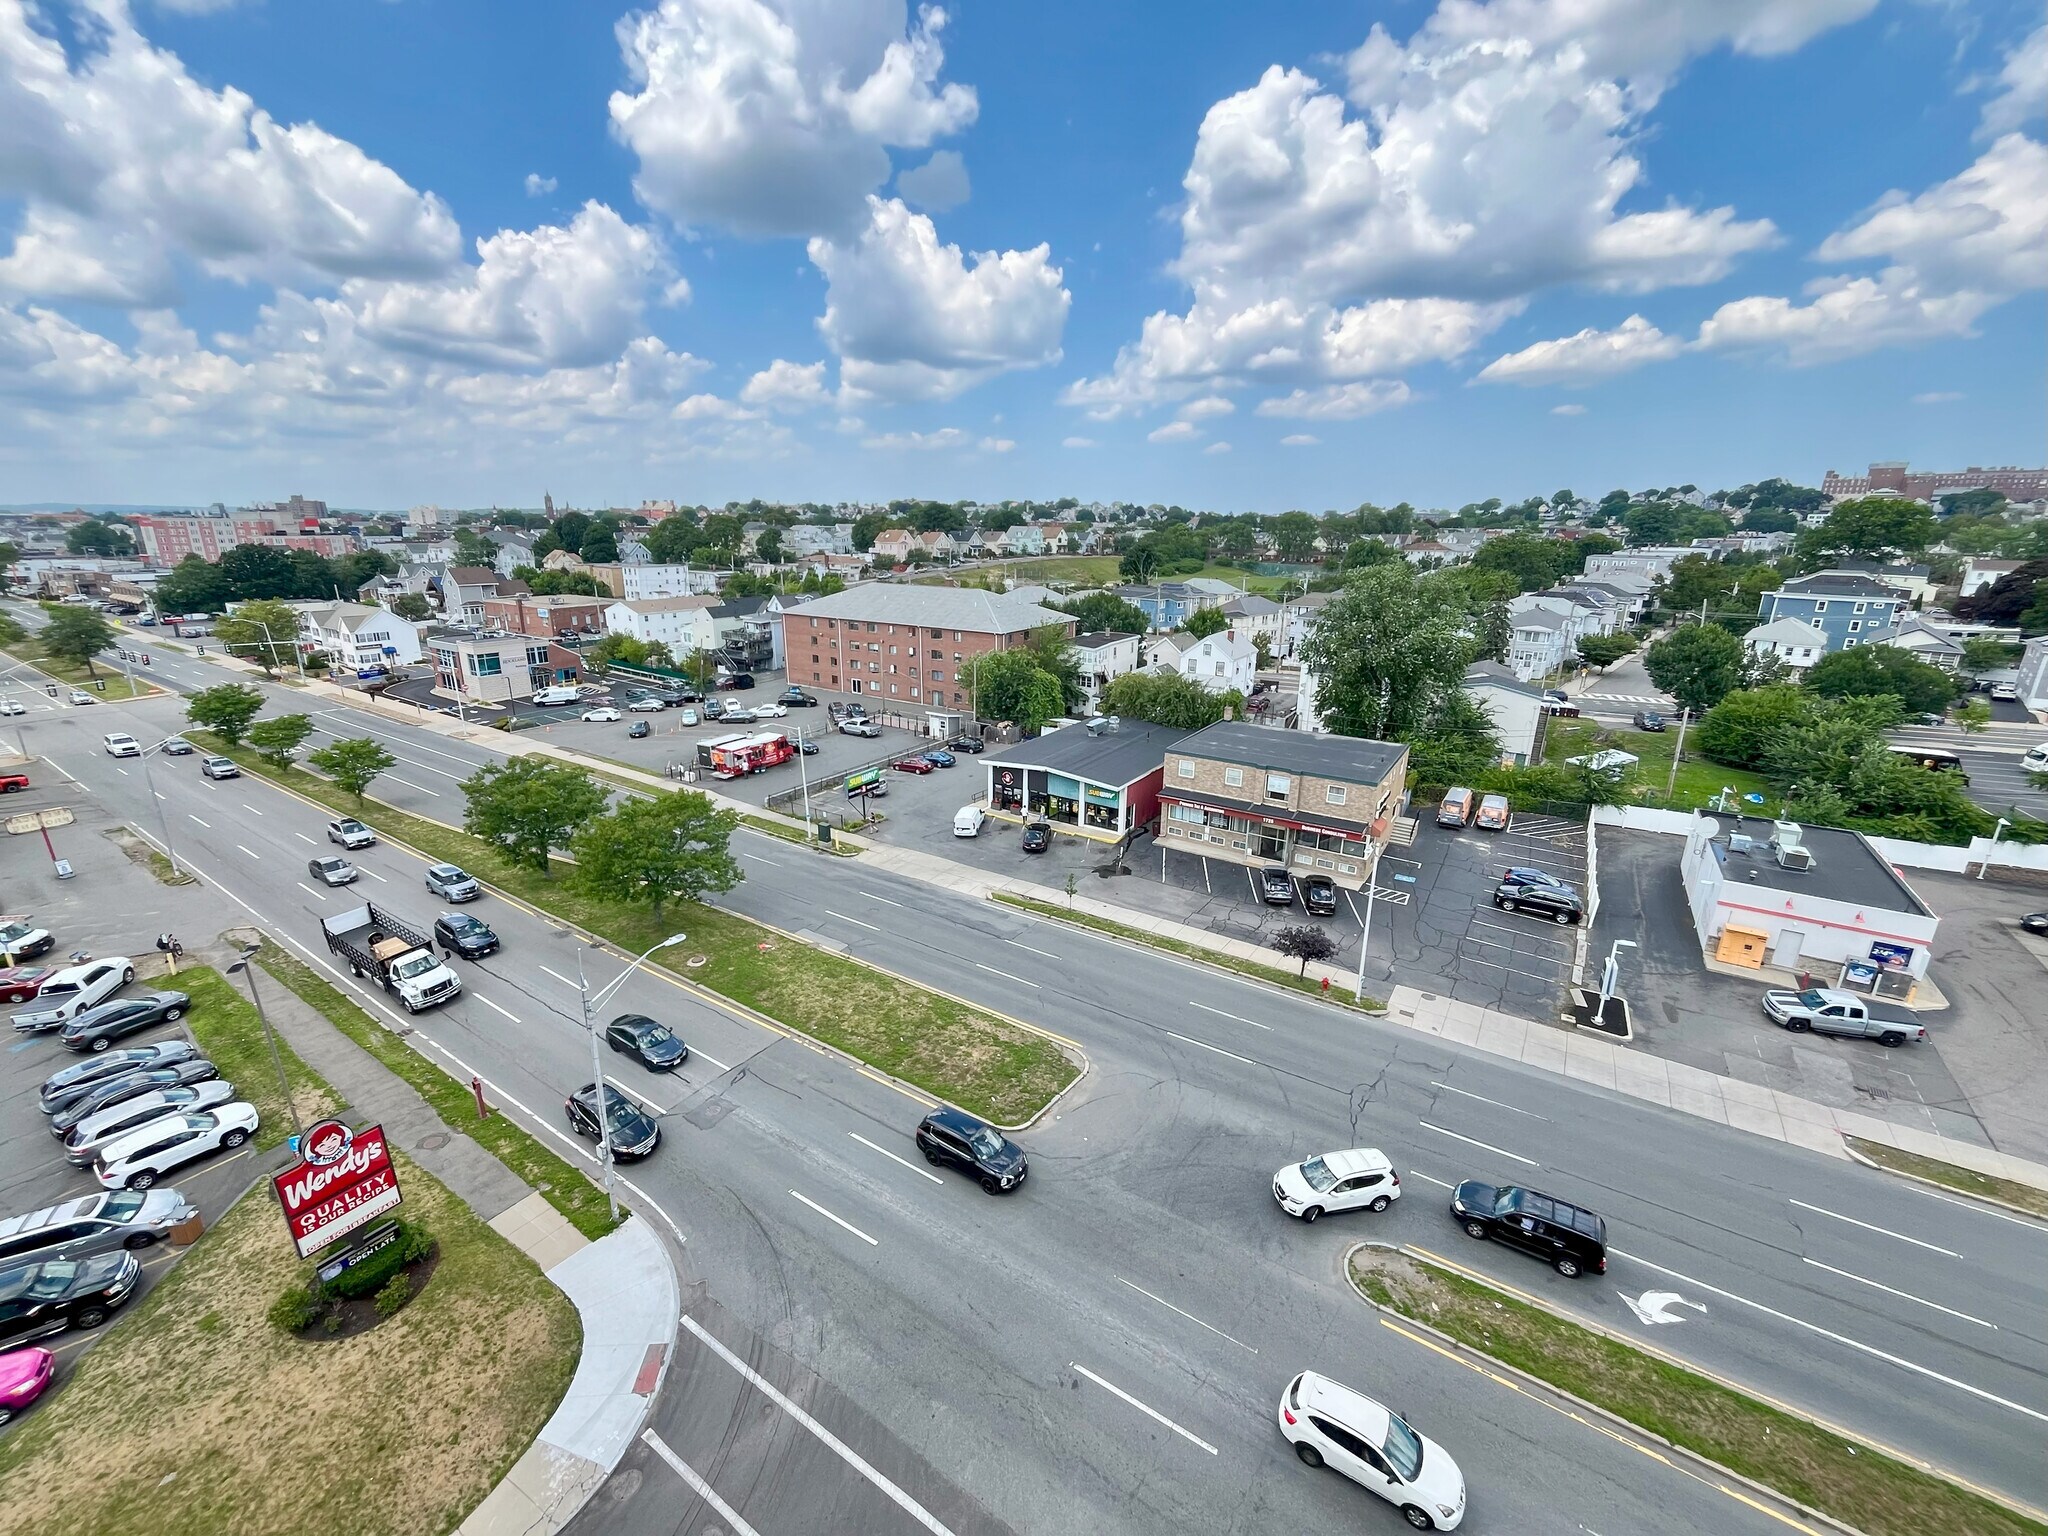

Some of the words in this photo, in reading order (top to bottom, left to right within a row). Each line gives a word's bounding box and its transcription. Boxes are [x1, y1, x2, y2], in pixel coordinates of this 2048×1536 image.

[848, 769, 878, 787] SUBWAY
[1087, 788, 1116, 799] SUBWAY
[284, 1141, 383, 1209] Wendy's
[300, 1172, 387, 1227] QUALITY
[303, 1223, 315, 1235] IS
[318, 1208, 345, 1225] OUR
[348, 1183, 390, 1210] RECIPE
[307, 1236, 333, 1253] OPEN
[333, 1225, 350, 1241] FOR
[350, 1199, 399, 1229] BREAKFAST
[348, 1248, 375, 1266] OPEN
[374, 1234, 396, 1252] LATE
